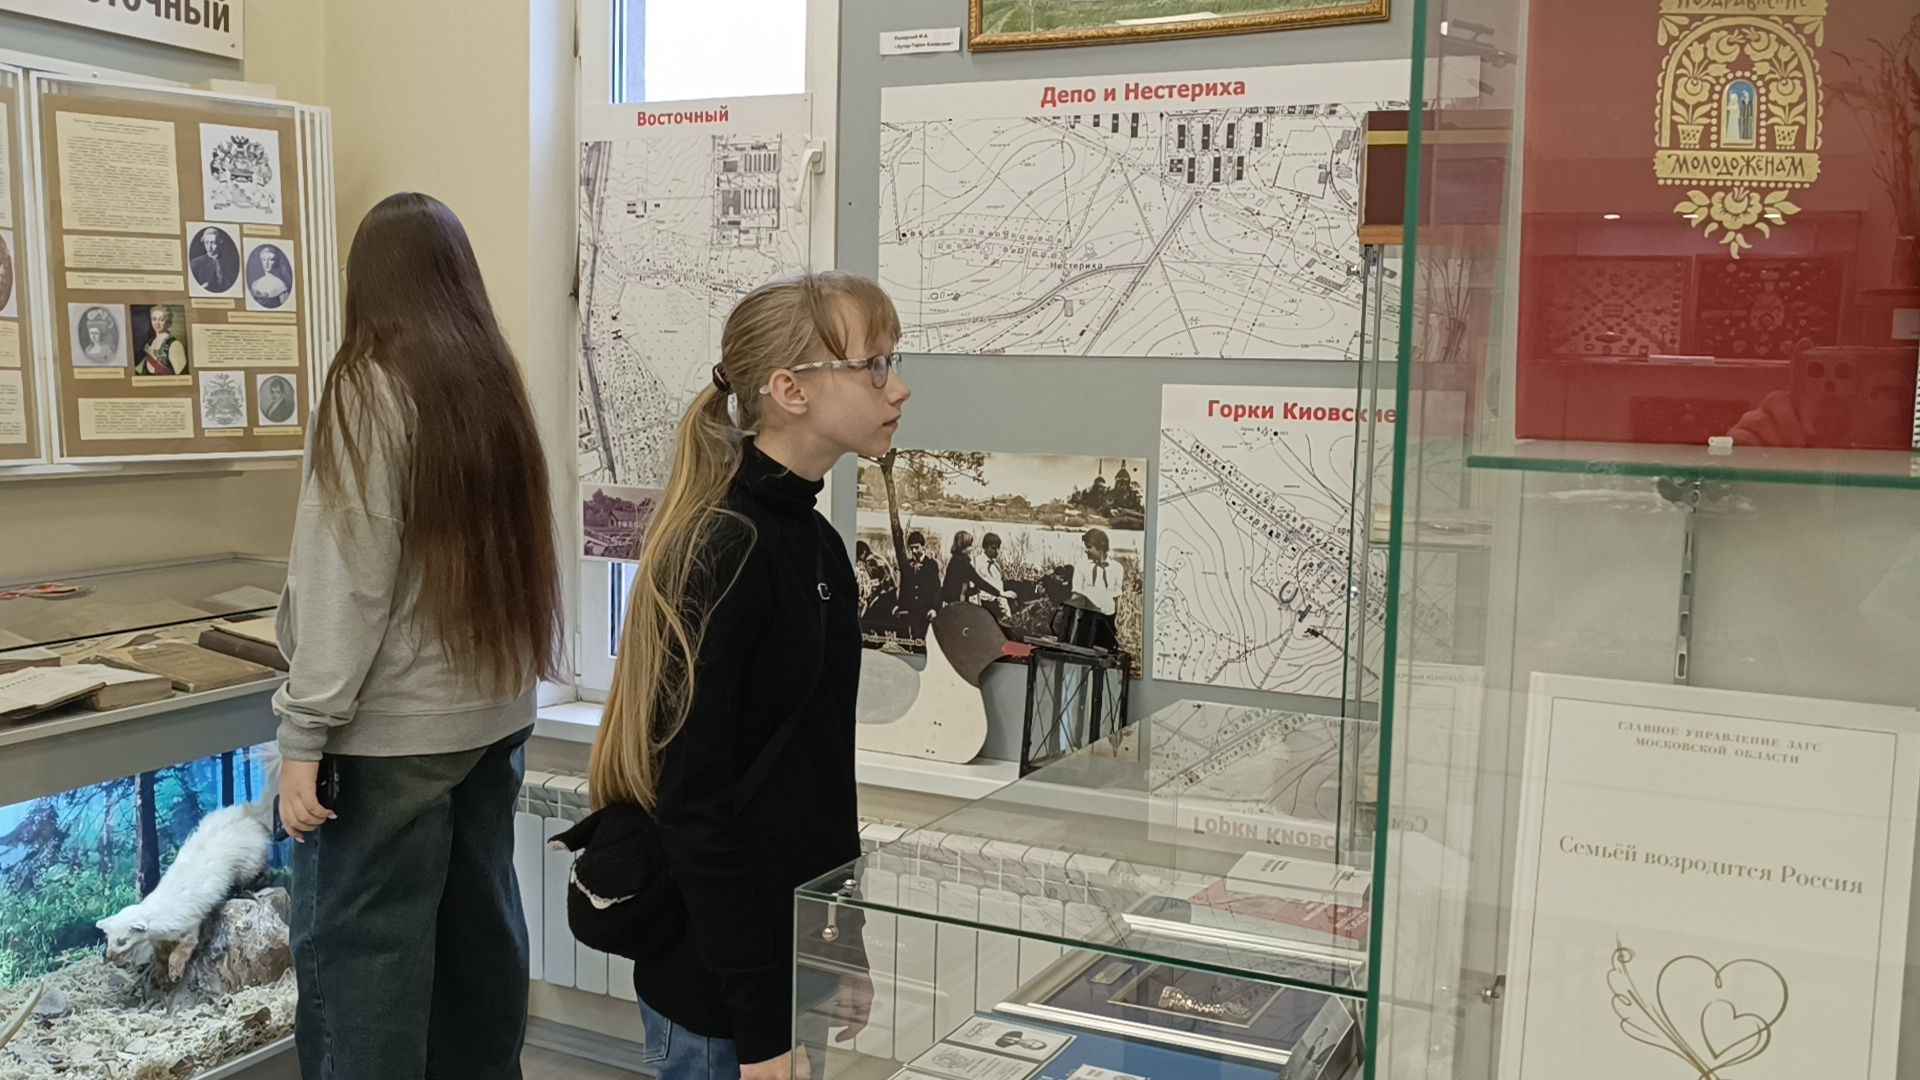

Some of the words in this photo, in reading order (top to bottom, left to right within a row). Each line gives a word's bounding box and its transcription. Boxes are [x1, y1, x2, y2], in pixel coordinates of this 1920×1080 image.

[1041, 87, 1096, 108] Депо
[1104, 88, 1116, 101] и
[1124, 81, 1246, 102] Нестериха
[637, 105, 729, 126] Восточный
[1050, 261, 1103, 271] Нестериха
[1208, 400, 1274, 422] Горки
[1617, 721, 1679, 737] ГЛАВНОЕ
[1686, 729, 1780, 748] УПРАВЛЕНИЕ
[1787, 740, 1823, 753] ЗАГС
[1635, 737, 1727, 756] МОСКОВСКОЙ
[1734, 749, 1800, 764] ОБЛАСТИ
[1559, 834, 1637, 863] Семьёй
[1644, 851, 1772, 881] возродится
[1780, 865, 1864, 894] Россия
